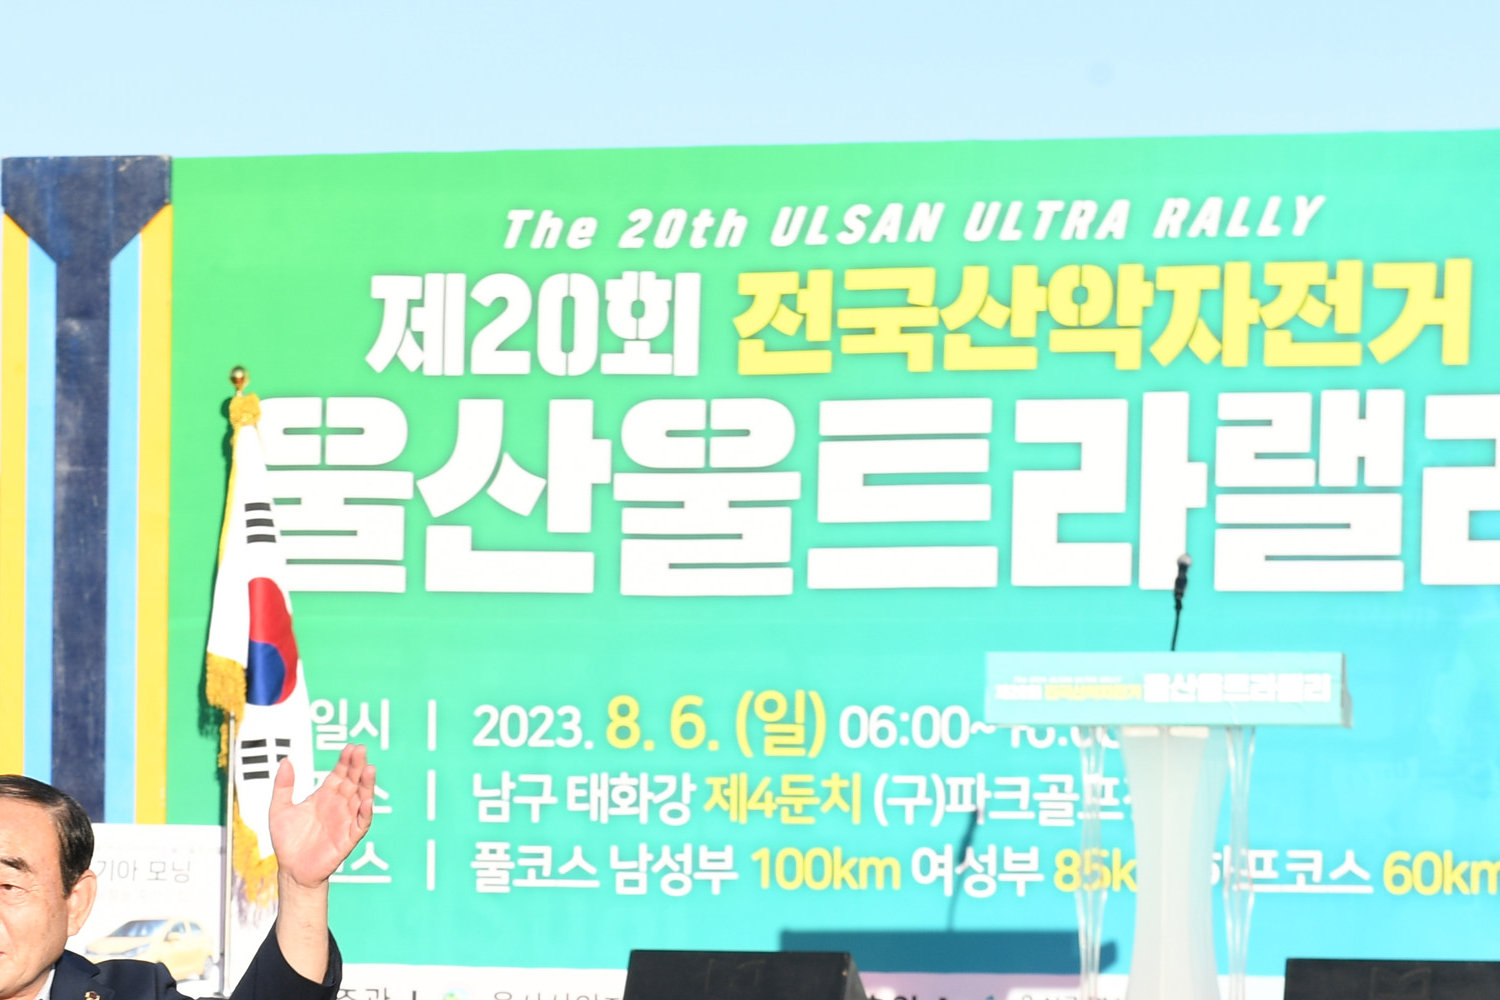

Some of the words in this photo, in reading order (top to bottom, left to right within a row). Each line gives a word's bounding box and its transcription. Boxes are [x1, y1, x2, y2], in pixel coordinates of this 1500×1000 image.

[503, 208, 598, 250] The
[617, 207, 748, 249] 20th
[769, 201, 946, 248] ULSAN
[963, 199, 1131, 243] ULTRA
[1152, 194, 1327, 240] RALLY
[364, 269, 702, 378] 제20회
[732, 257, 1473, 377] 전국산악자전거
[309, 697, 391, 751] 일시
[472, 703, 595, 751] 2023.
[605, 694, 656, 752] 8.
[669, 694, 720, 752] 6.
[735, 688, 827, 759] (일)
[472, 769, 559, 824] 남구
[566, 771, 698, 827] 태화강
[702, 771, 862, 826] 제4둔치
[873, 771, 1132, 828] (구)파크골프
[97, 859, 138, 882] 기아
[147, 859, 192, 884] 모닝
[328, 840, 393, 884] 스
[469, 840, 601, 894] 풀코스
[609, 841, 740, 898] 남성부
[750, 845, 902, 891] 100km
[910, 842, 1046, 899] 여성부
[1053, 846, 1138, 893] 85k
